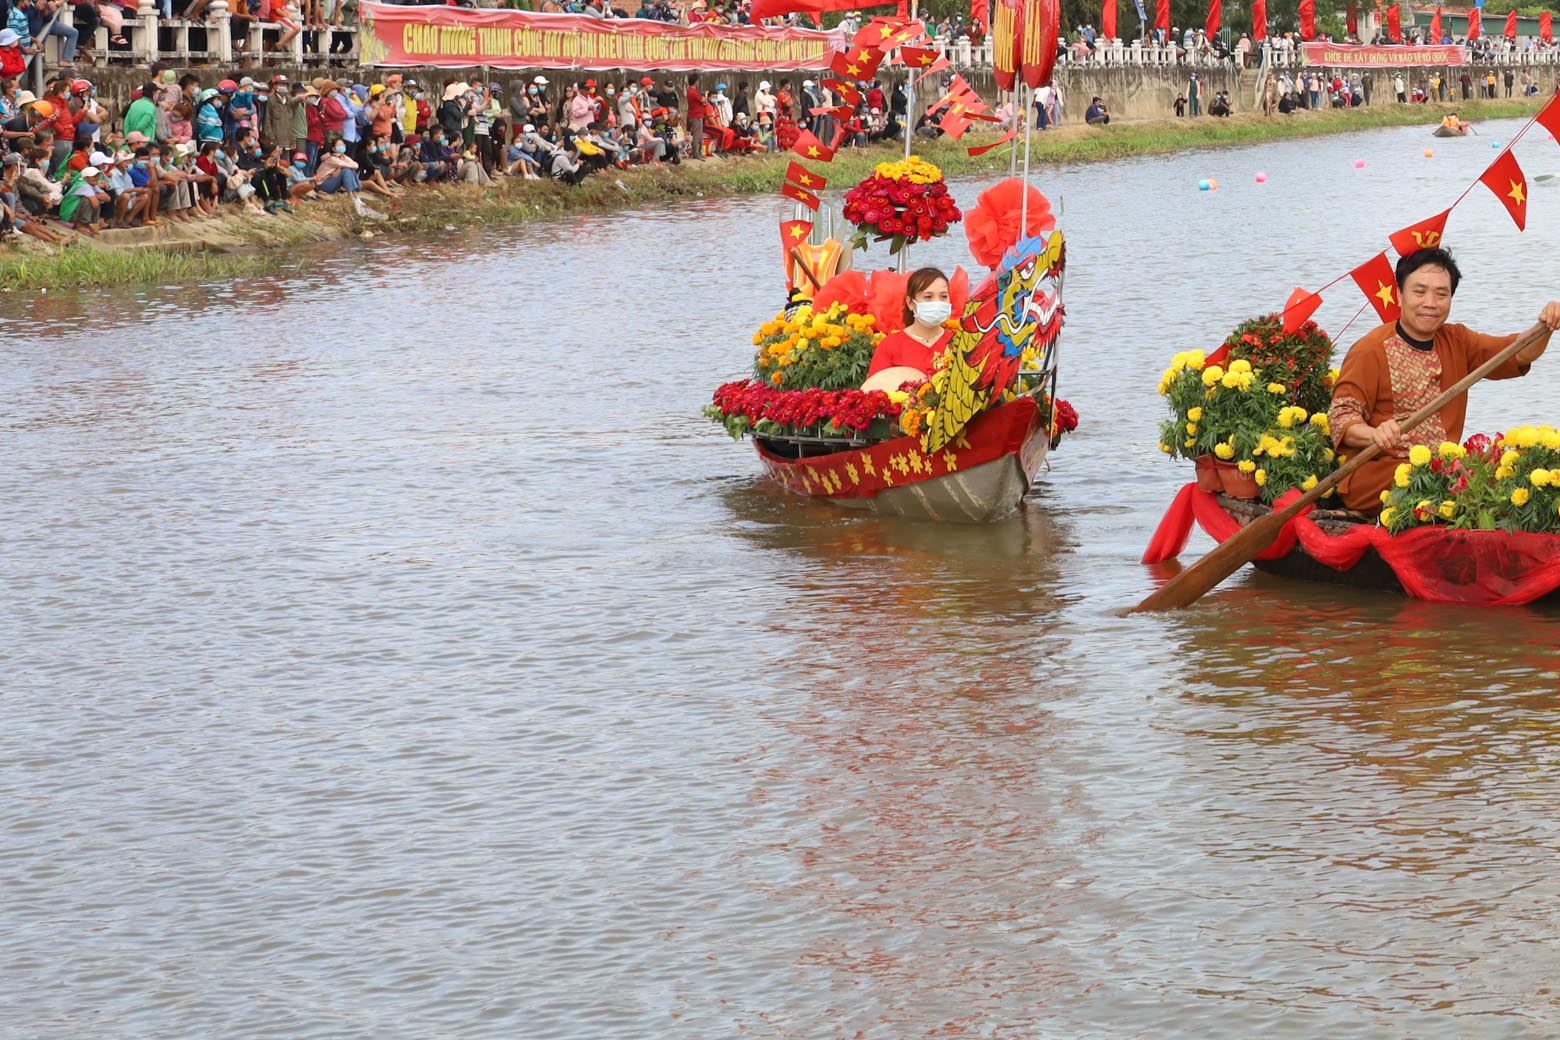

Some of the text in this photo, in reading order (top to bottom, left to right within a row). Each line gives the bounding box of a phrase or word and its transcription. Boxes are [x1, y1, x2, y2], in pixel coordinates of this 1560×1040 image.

[403, 17, 438, 54] CHÀO
[440, 19, 476, 56] MỪNG
[514, 24, 542, 56] CÔNG
[1353, 50, 1367, 62] XÂY
